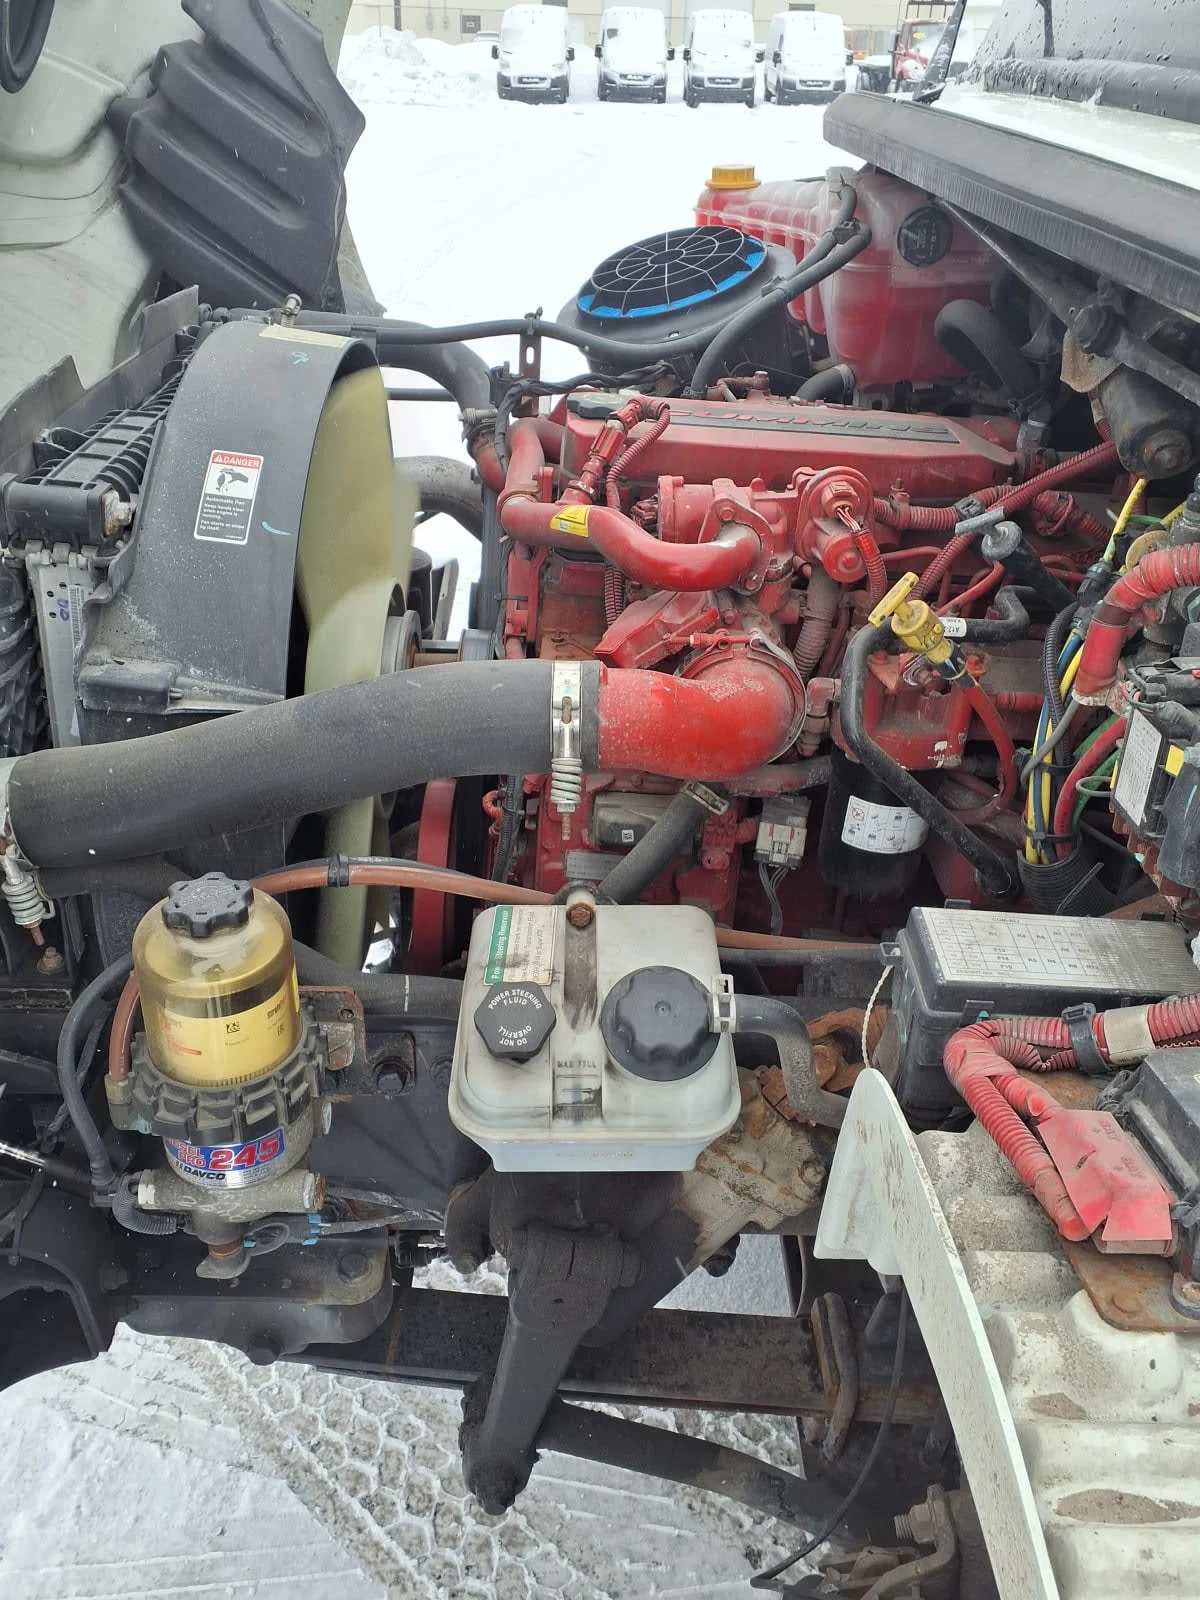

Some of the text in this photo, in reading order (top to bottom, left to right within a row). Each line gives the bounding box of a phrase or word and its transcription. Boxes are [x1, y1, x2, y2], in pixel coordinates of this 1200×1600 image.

[223, 456, 259, 467] DANGER
[488, 989, 542, 1010] POWER STEERING
[503, 997, 528, 1006] FLUID
[498, 1025, 532, 1039] OVERFILL
[499, 1037, 528, 1047] DO NOT
[177, 1149, 207, 1168] PRO
[209, 1133, 281, 1171] 245
[183, 1166, 226, 1180] DAVCO
